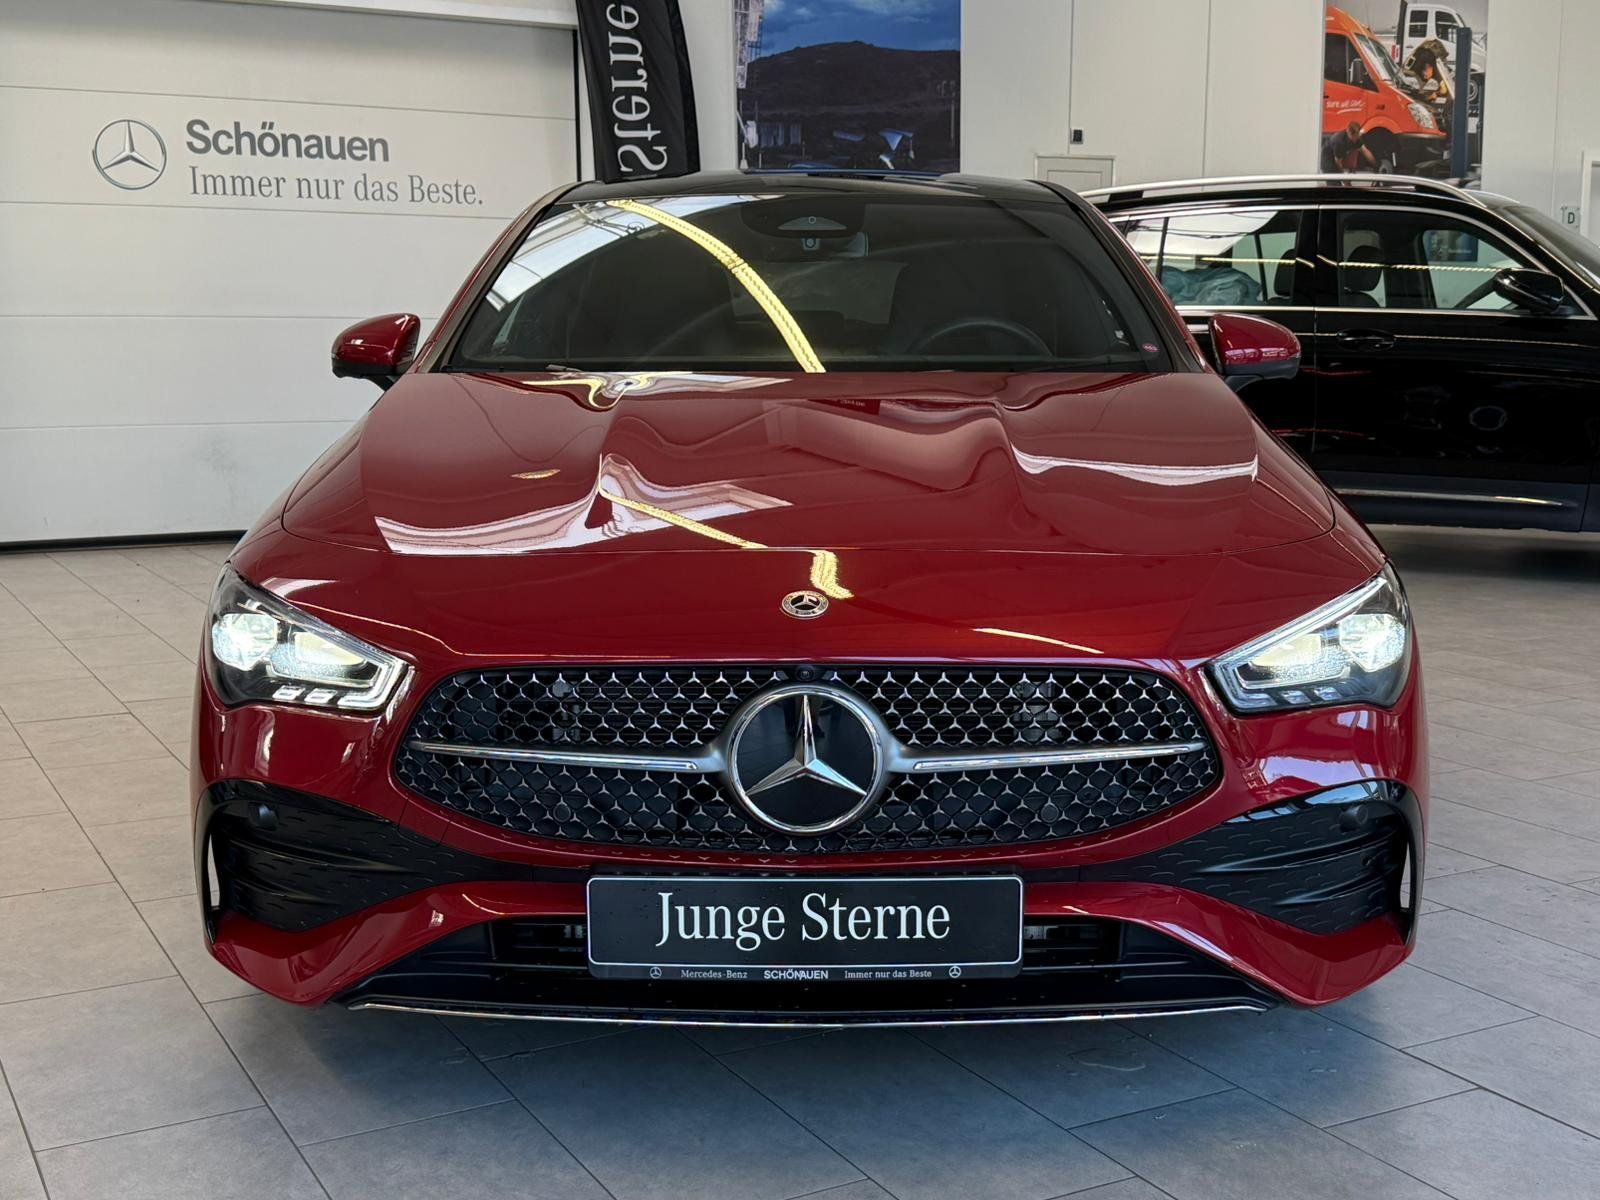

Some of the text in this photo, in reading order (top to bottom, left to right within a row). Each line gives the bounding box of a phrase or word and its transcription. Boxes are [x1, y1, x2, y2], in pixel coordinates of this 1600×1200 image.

[186, 119, 390, 162] Schönauen
[189, 165, 483, 205] Immer nur das Beste.
[655, 892, 950, 951] Junge Sterne
[681, 968, 932, 981] Mercedes-Benz SCHÖNAUEN Immer nur das Beste
